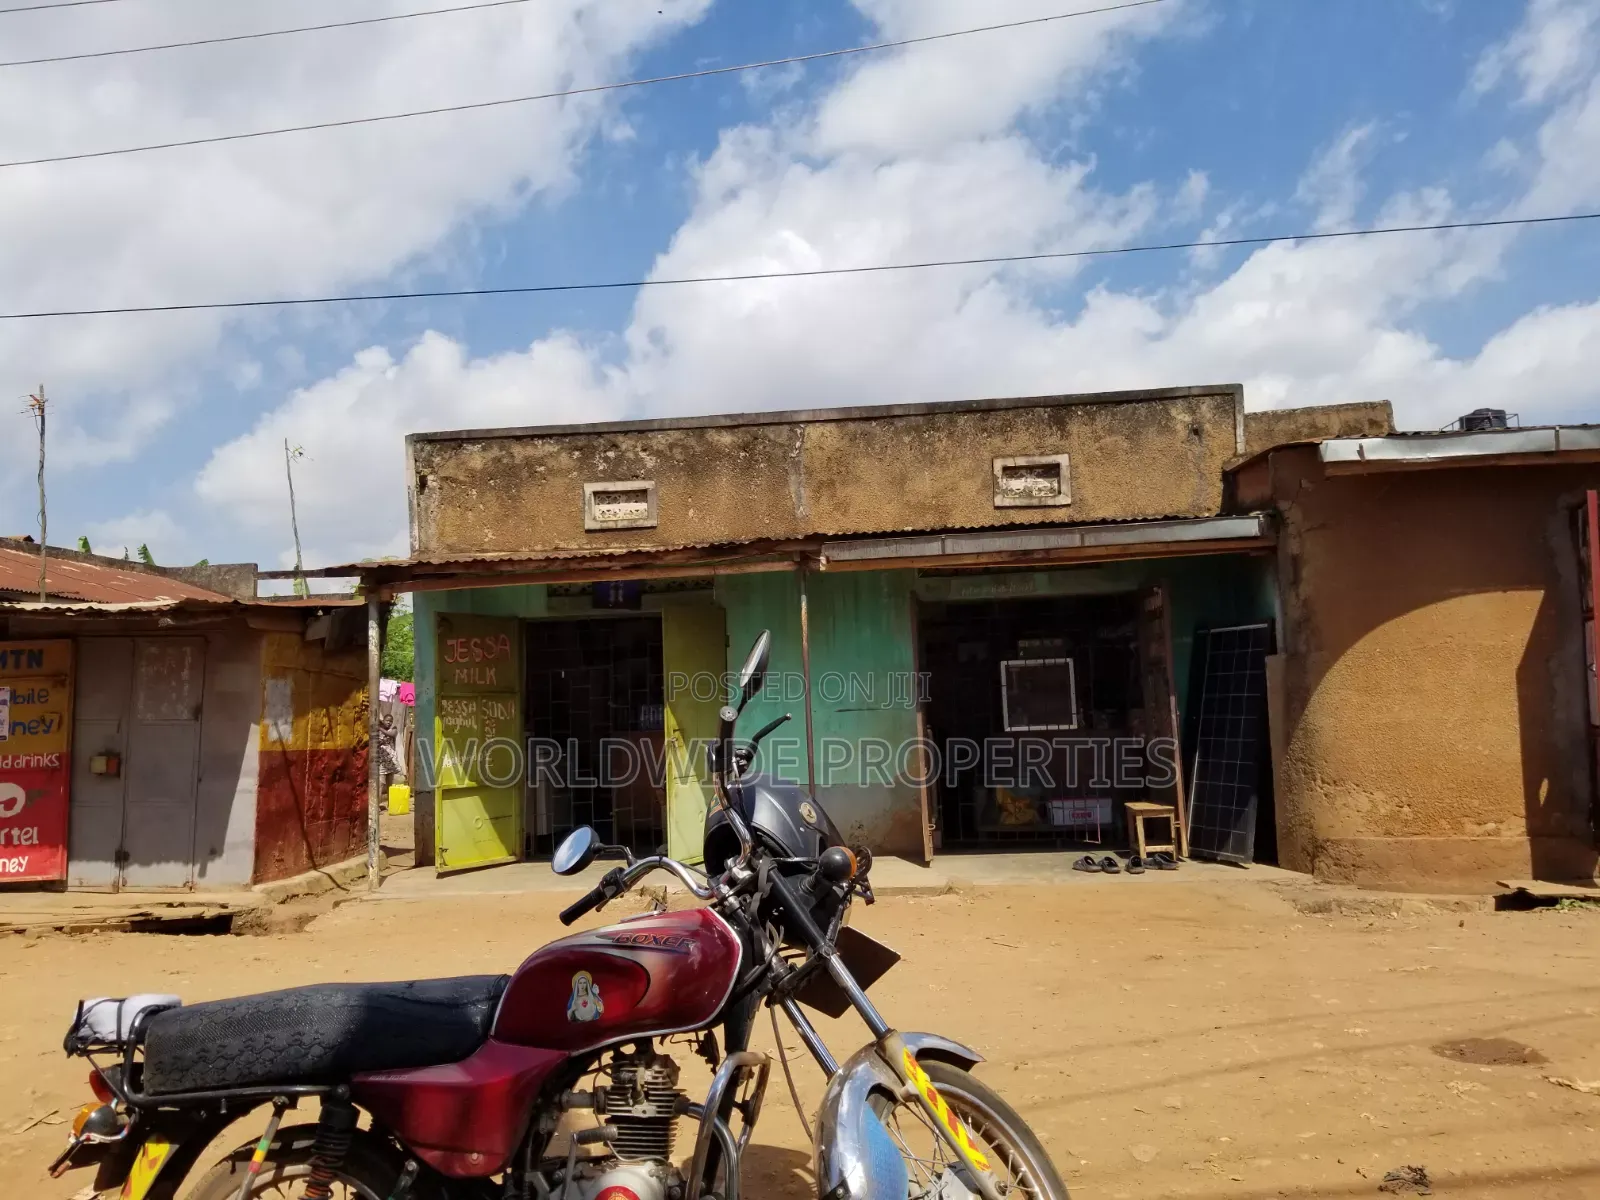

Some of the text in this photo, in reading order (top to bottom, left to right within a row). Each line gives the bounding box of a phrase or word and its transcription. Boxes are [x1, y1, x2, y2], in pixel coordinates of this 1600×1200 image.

[444, 633, 511, 664] JESSA
[455, 665, 497, 686] MILK
[10, 688, 49, 705] bile
[9, 718, 54, 736] ney
[14, 752, 60, 769] drinks
[0, 826, 39, 846] rtel
[0, 856, 29, 873] ney
[612, 932, 698, 949] BOXER
